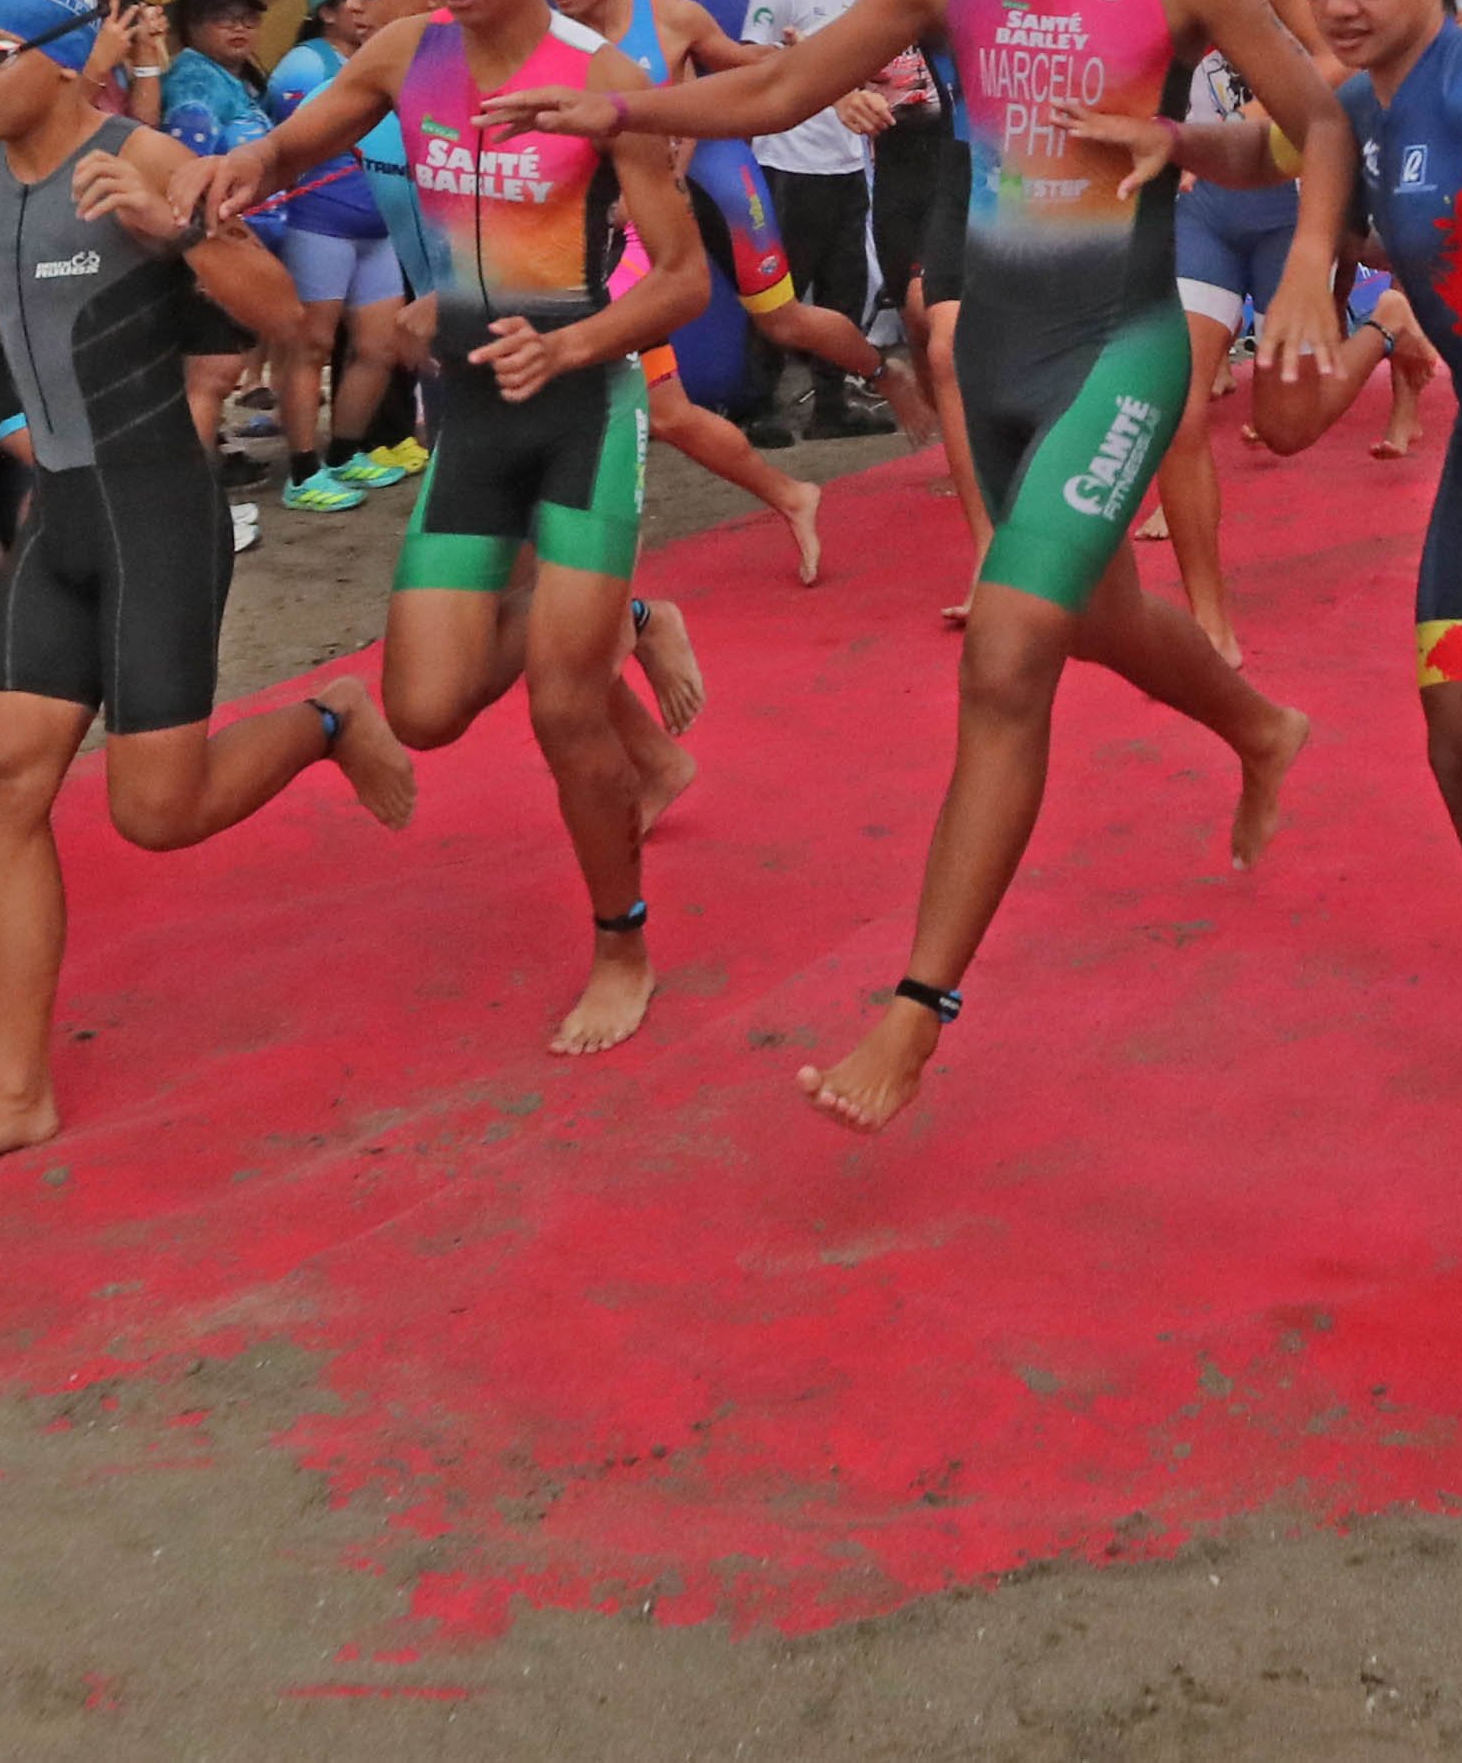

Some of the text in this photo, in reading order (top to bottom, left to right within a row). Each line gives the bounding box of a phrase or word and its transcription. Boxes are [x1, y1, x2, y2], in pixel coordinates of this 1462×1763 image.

[994, 26, 1090, 51] BARLEY
[1006, 10, 1083, 34] SANTÉ
[978, 47, 1106, 106] MARCELO
[1003, 102, 1070, 158] PHI
[426, 138, 542, 179] SANTÉ
[414, 162, 554, 204] BARLEY
